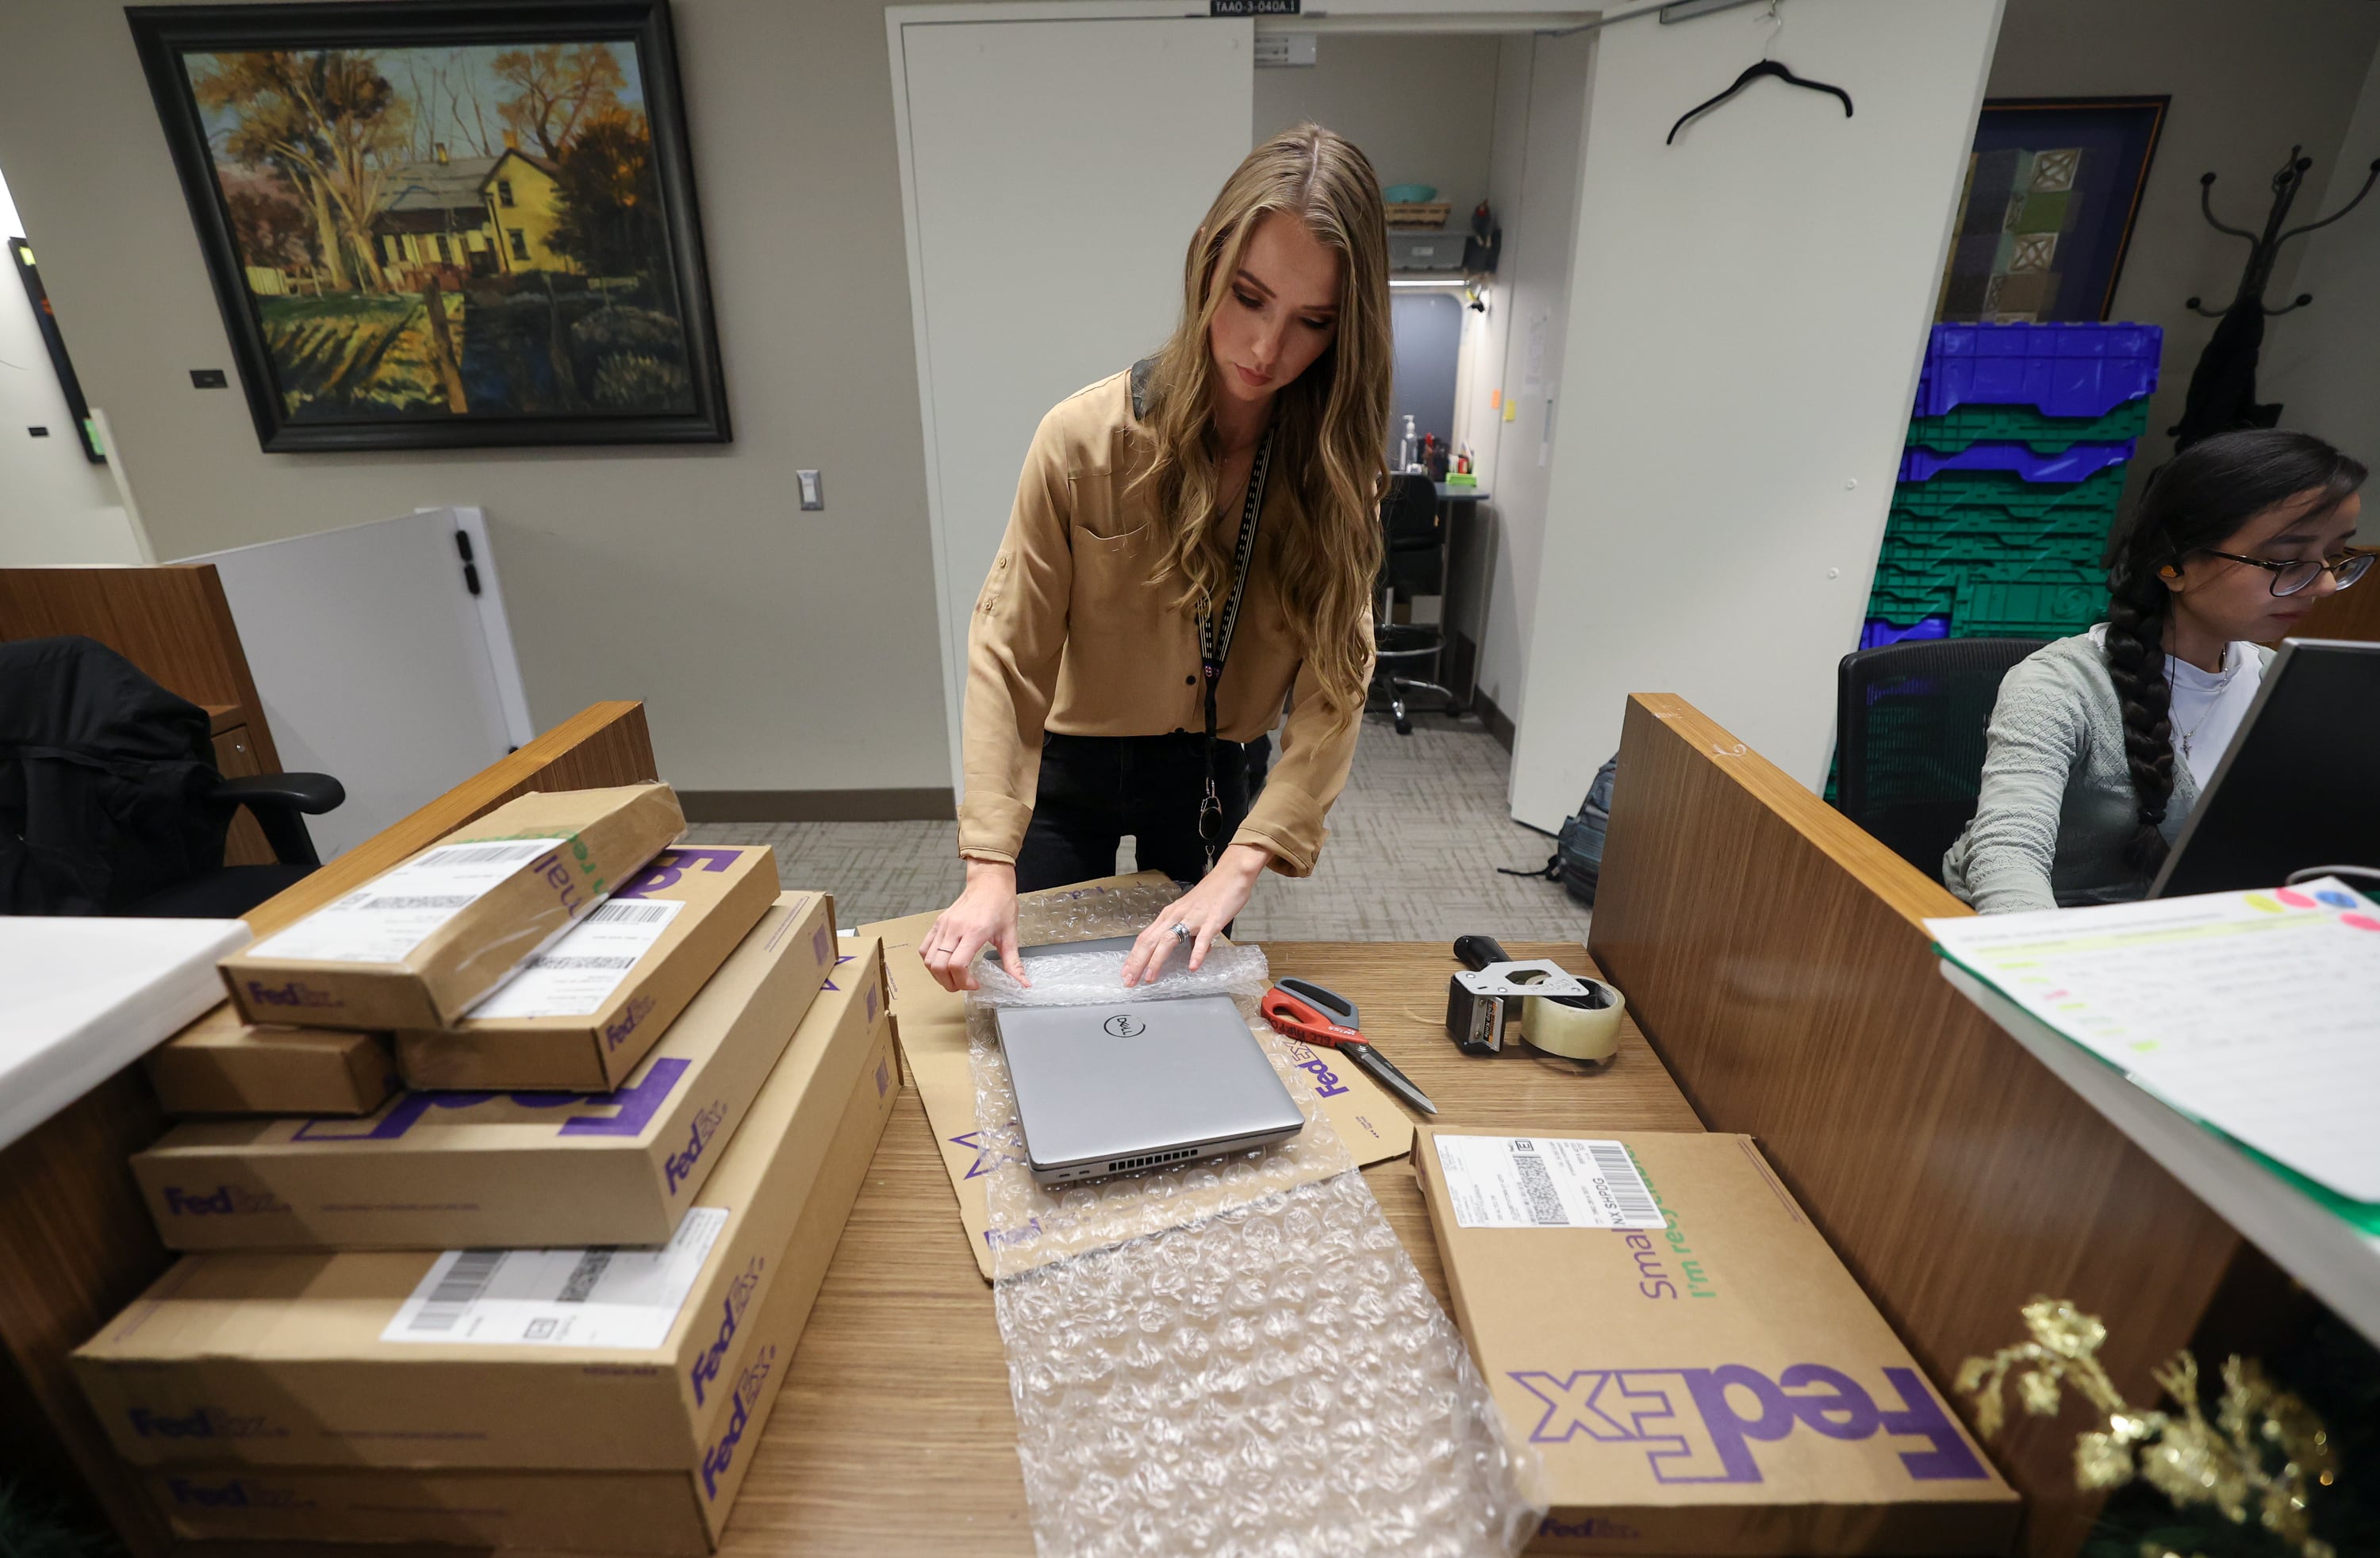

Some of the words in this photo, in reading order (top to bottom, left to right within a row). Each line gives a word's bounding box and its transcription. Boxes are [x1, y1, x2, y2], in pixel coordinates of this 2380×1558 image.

[1117, 1018, 1133, 1035] DELL
[1611, 1227, 1679, 1299] Smal
[1680, 1261, 1717, 1299] I'm
[1507, 1363, 1990, 1484] FedEx
